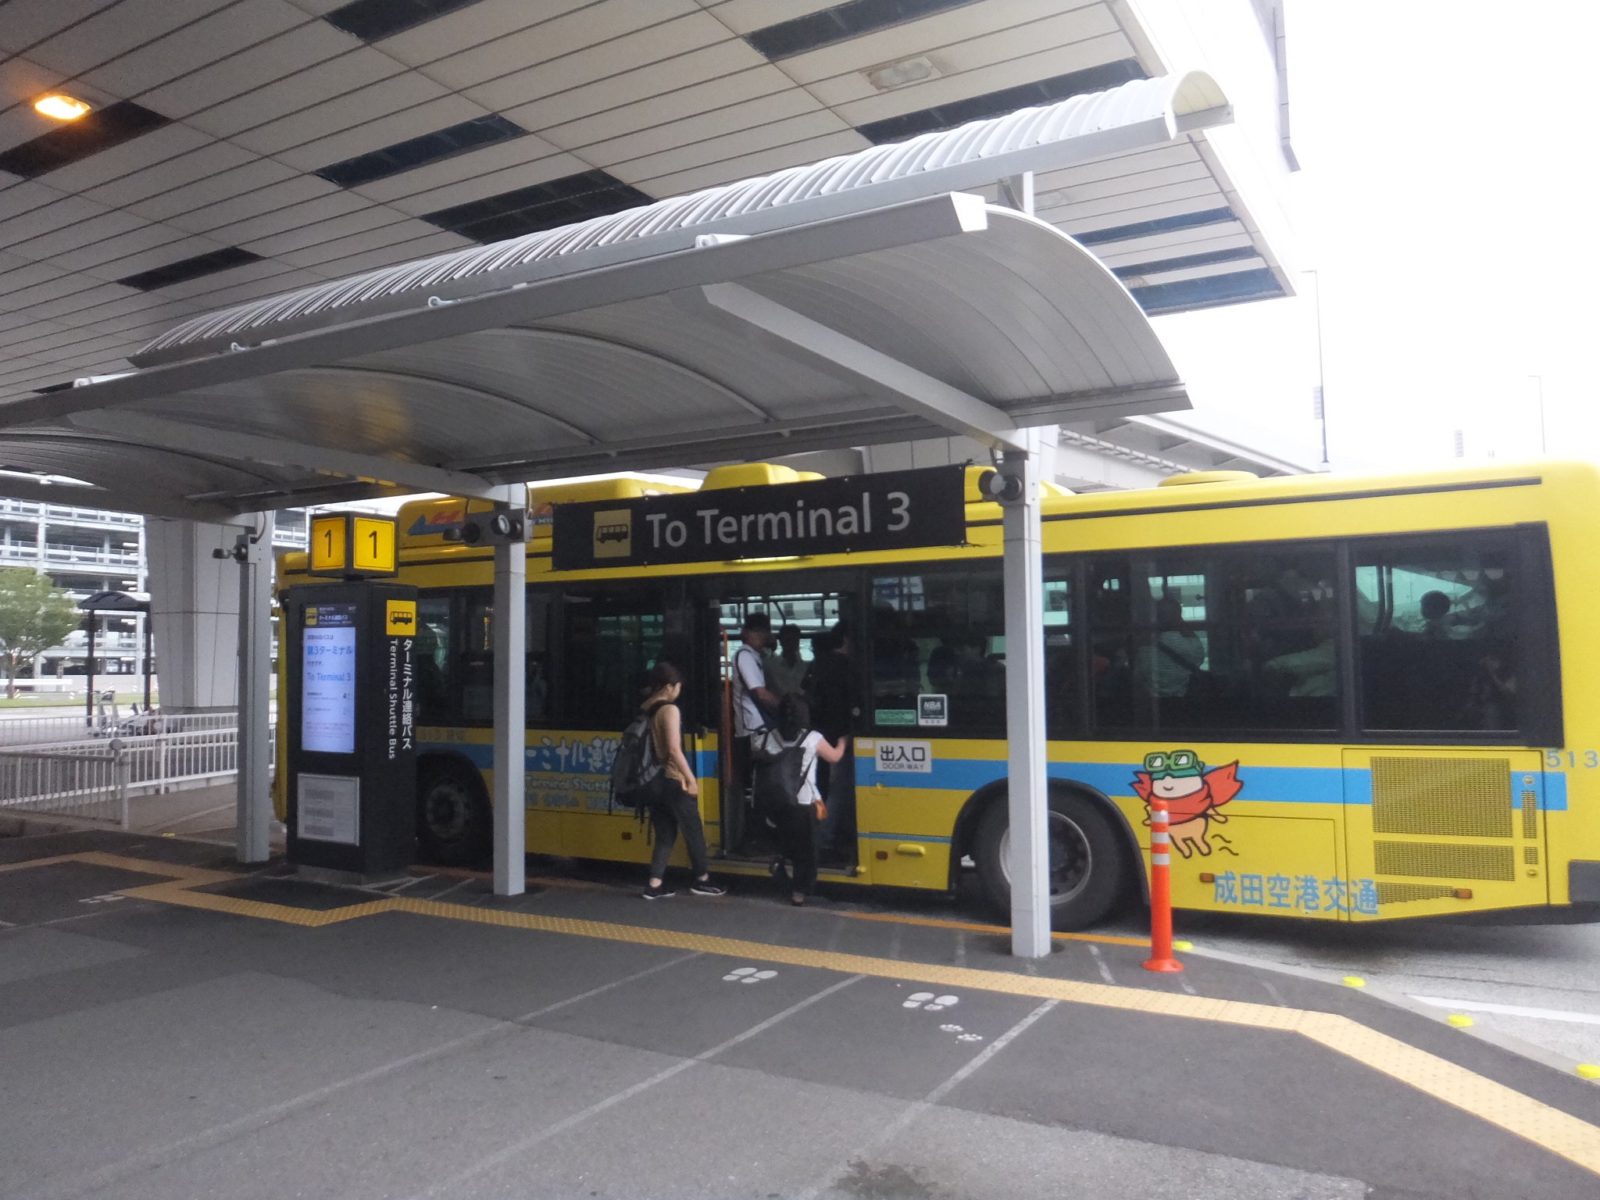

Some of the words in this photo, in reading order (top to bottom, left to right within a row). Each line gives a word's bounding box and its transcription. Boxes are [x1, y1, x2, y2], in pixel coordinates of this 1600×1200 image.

[646, 513, 687, 547] To
[697, 492, 871, 545] Terminal
[887, 491, 911, 532] 3
[324, 529, 332, 558] 1
[368, 530, 378, 559] 1
[389, 639, 399, 690] Terminal
[402, 638, 413, 750] ターミナル連絡バス
[388, 693, 397, 735] Shuttle
[388, 738, 397, 759] Bus
[880, 745, 926, 762] 出入口
[1546, 748, 1600, 769] 513
[1214, 870, 1378, 915] 成田空港交通
